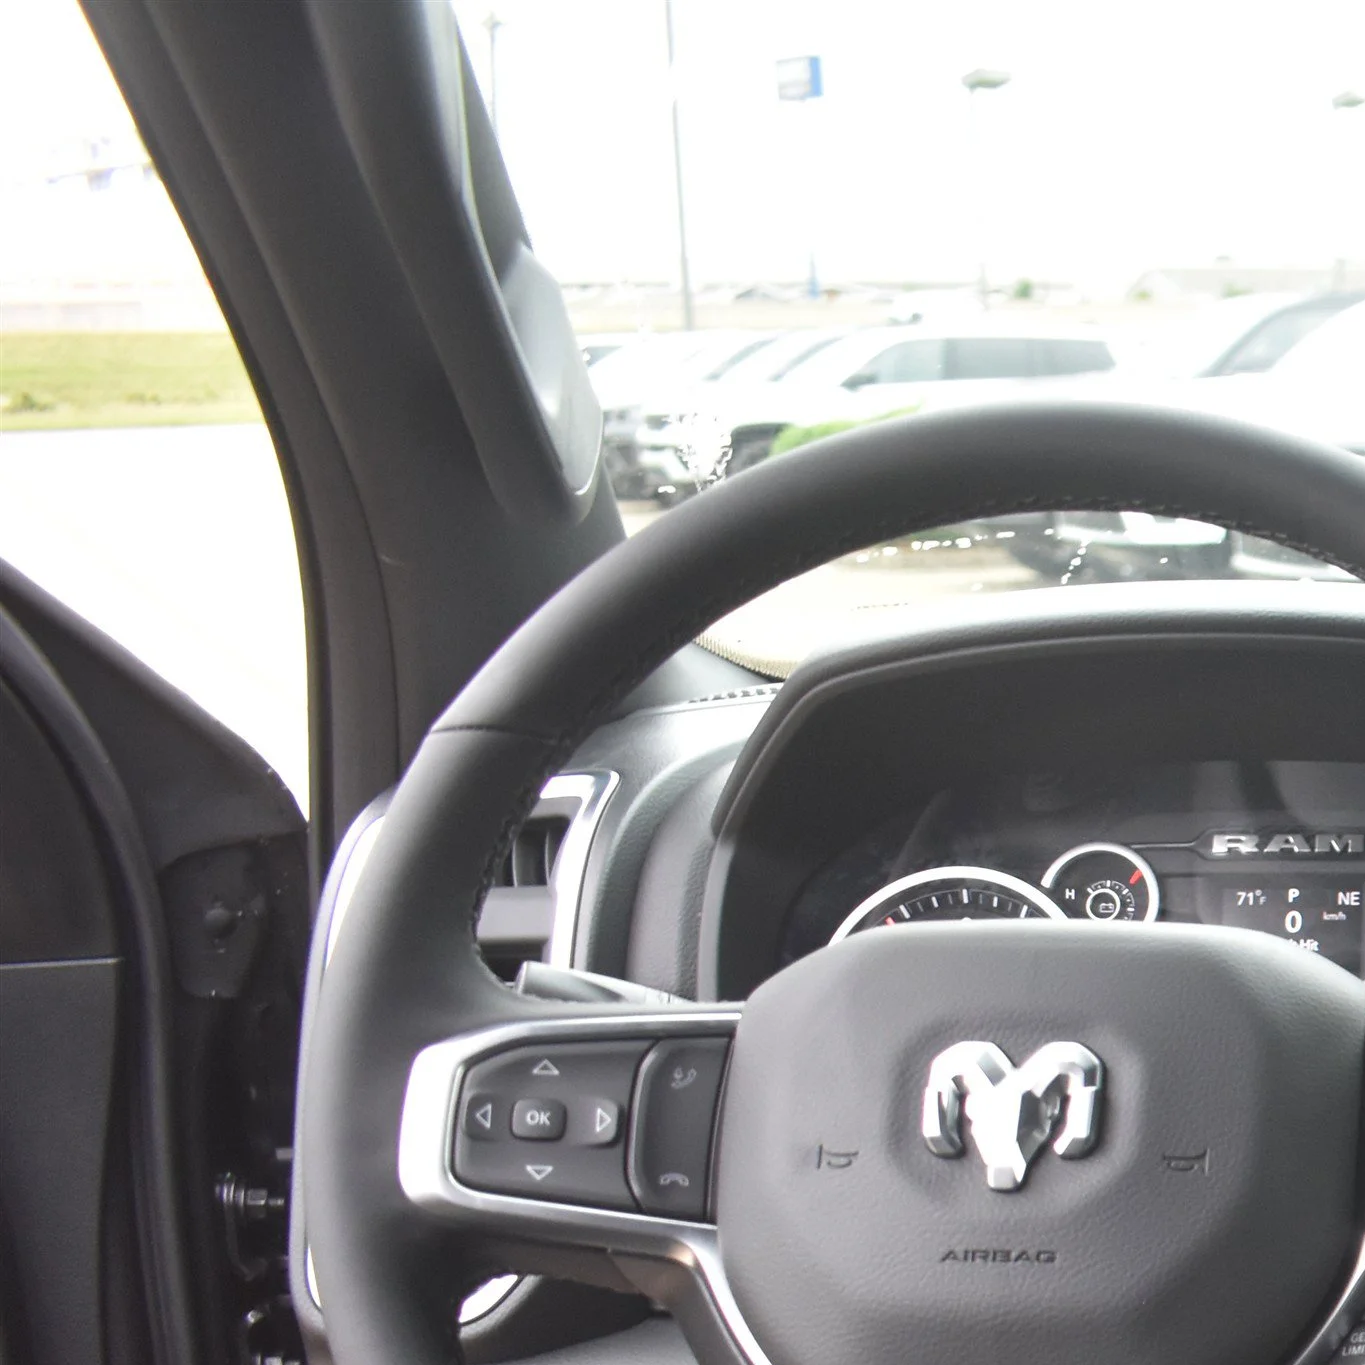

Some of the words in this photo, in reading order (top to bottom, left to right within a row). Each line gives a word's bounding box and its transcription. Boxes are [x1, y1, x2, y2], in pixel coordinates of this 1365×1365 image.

[1211, 834, 1365, 853] RAM
[1065, 888, 1076, 900] H
[1288, 888, 1300, 903] P
[1337, 891, 1361, 906] NE
[1284, 911, 1303, 934] 0
[526, 1110, 551, 1126] OK
[940, 1249, 1058, 1263] AIRBAG
